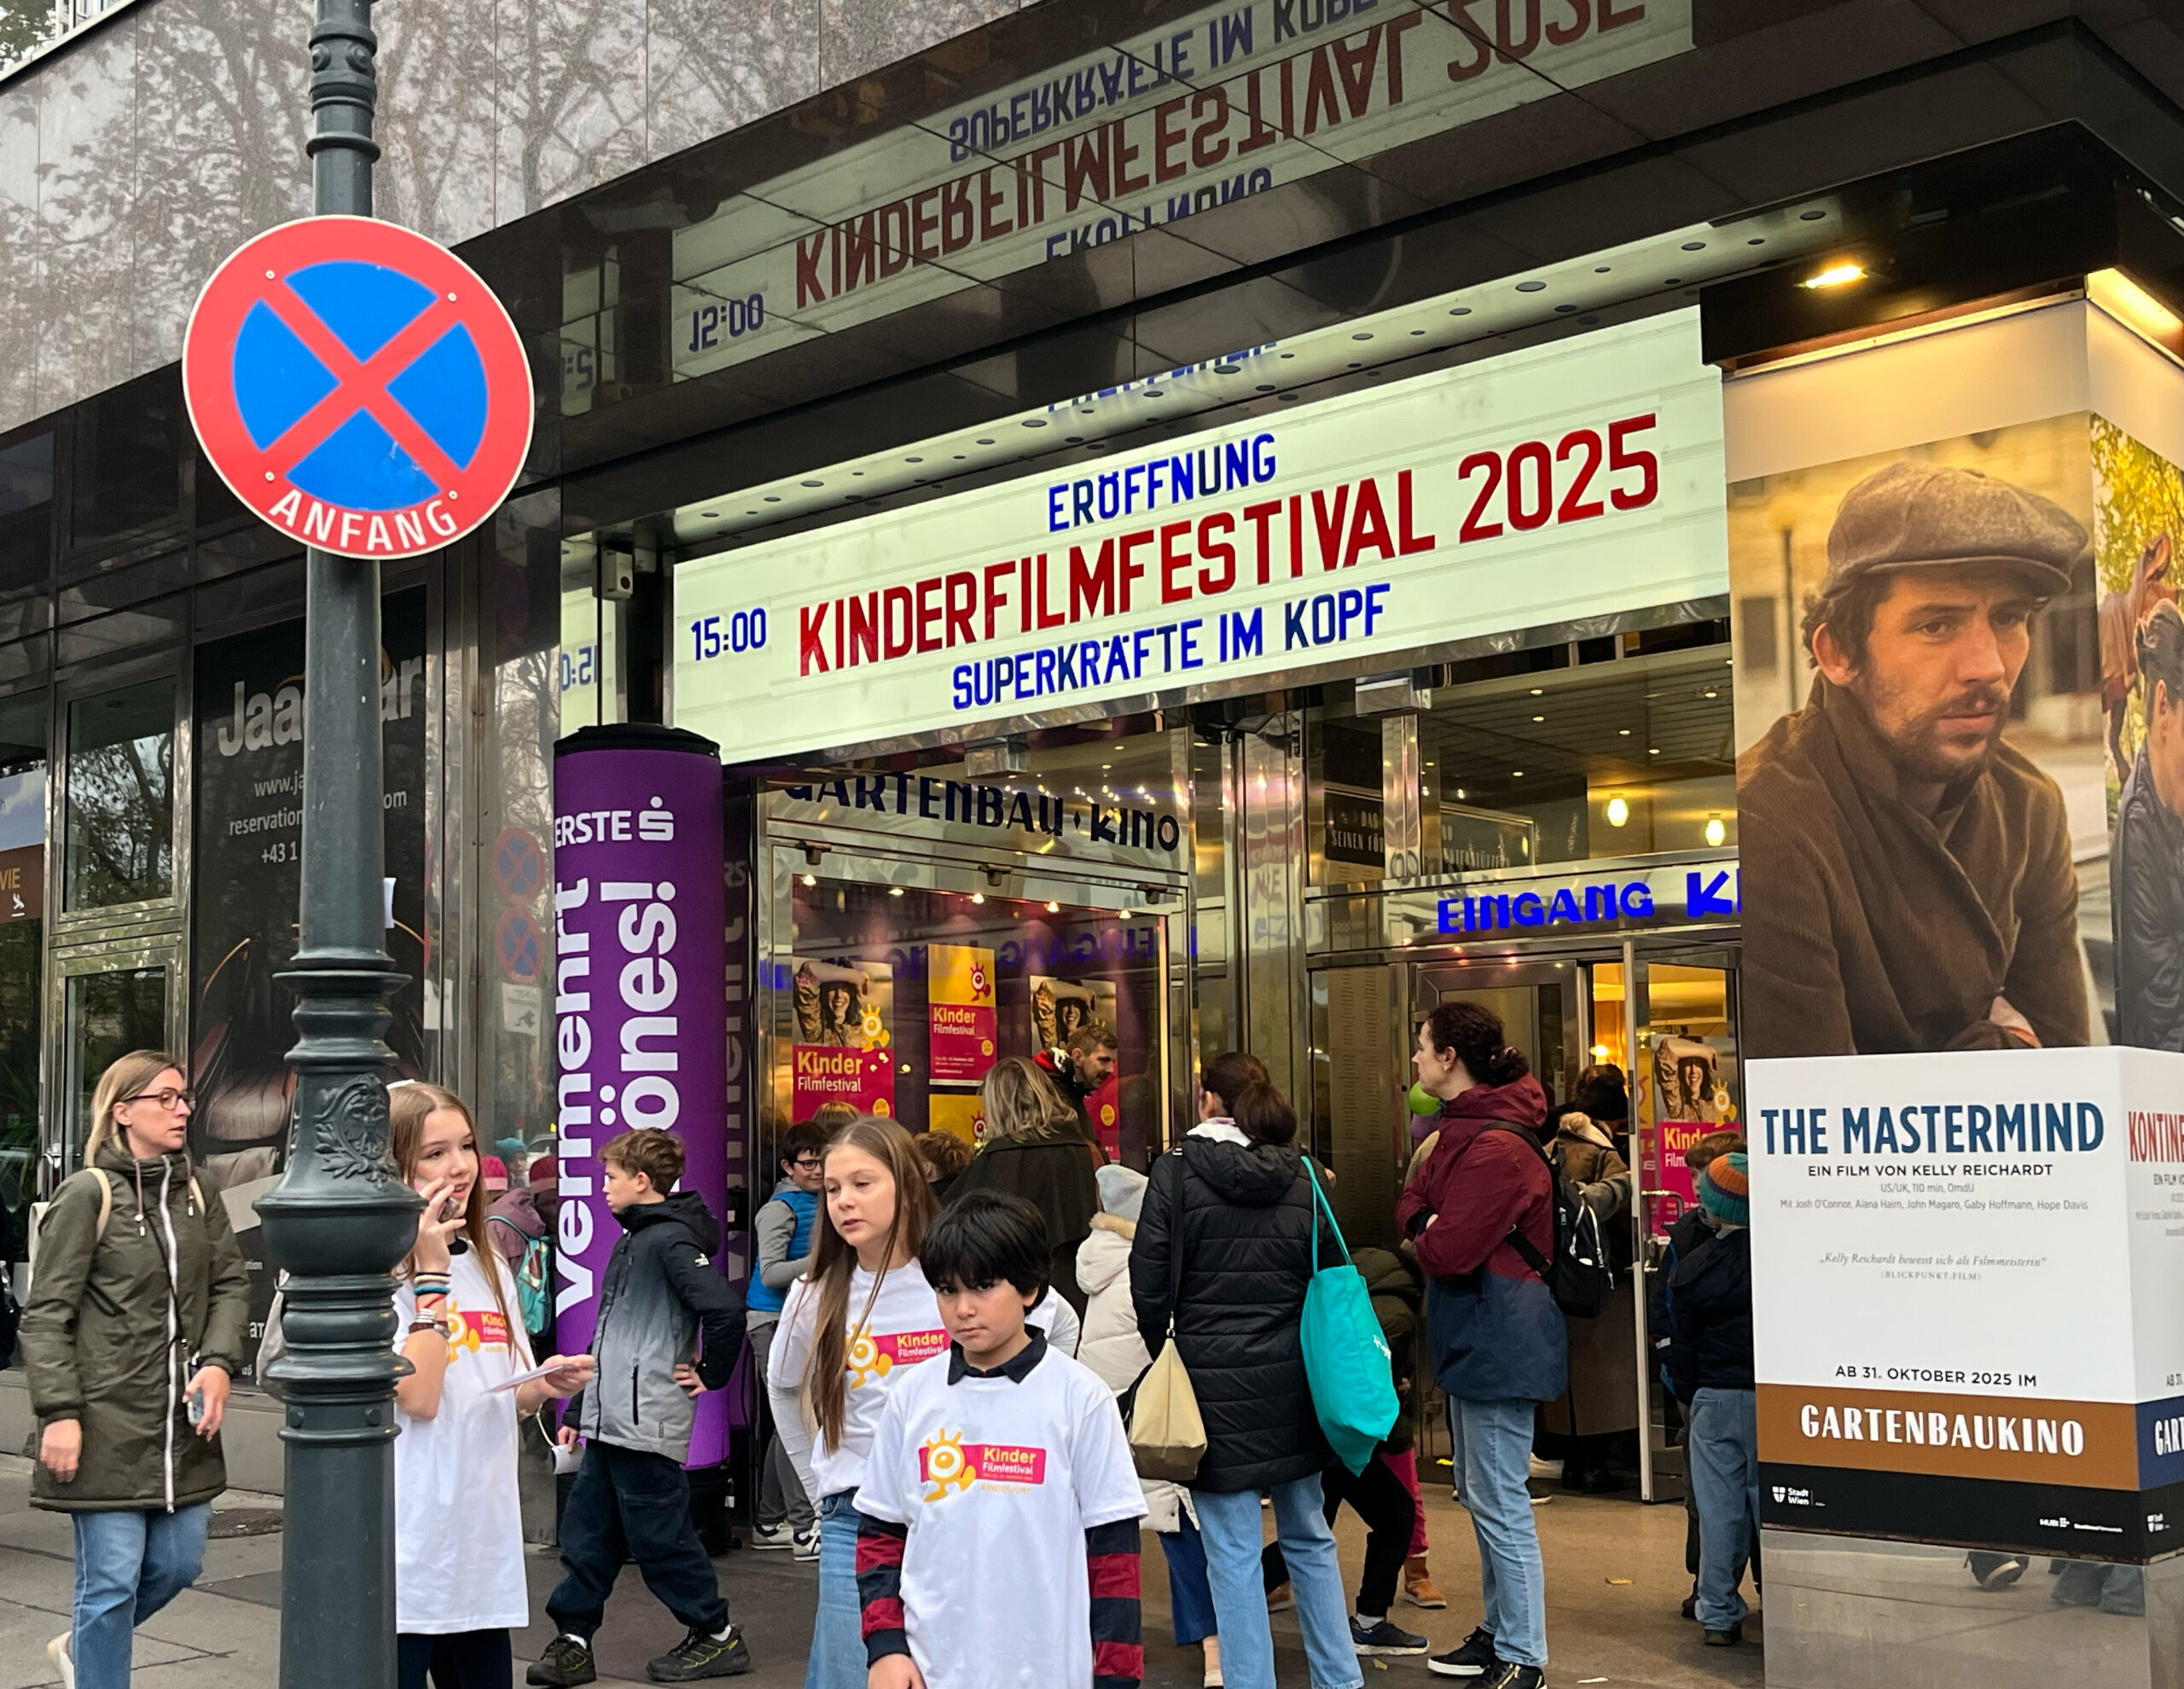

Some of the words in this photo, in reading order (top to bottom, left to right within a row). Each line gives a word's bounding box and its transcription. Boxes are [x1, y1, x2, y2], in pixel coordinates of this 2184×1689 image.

[1048, 433, 1276, 532] ERÖFFNUNG
[268, 490, 458, 554] ANFANG
[800, 470, 1435, 676] KINDERFILMFESTIVAL
[1458, 413, 1658, 543] 2025
[691, 607, 766, 660] 15:00
[953, 619, 1204, 710] SUPERKRÄFTE
[1219, 607, 1263, 663] IM
[1285, 583, 1391, 657] KOPF
[555, 810, 632, 849] ERSTE
[1090, 803, 1180, 852] KINO
[261, 842, 286, 863] +43
[1437, 881, 1655, 934] EINGANG
[933, 1007, 976, 1024] Kinder
[933, 1023, 975, 1036] Filmfestival
[798, 1051, 863, 1075] Kinder
[797, 1077, 863, 1092] Filmfestival
[1760, 1108, 1828, 1155] THE
[1843, 1102, 2105, 1154] MASTERMIND
[1808, 1165, 1832, 1177] EIN
[1837, 1165, 1870, 1176] FILM
[1874, 1165, 1907, 1176] VON
[1912, 1164, 1957, 1176] KELLY
[1963, 1164, 2053, 1176] REICHARDT
[1780, 1199, 1792, 1209] Mit
[1907, 1199, 1926, 1210] John
[1964, 1199, 1986, 1211] Gaby
[2037, 1200, 2061, 1211] Hope
[2063, 1199, 2088, 1210] Davis
[897, 1332, 945, 1348] Kinder
[897, 1344, 944, 1358] Filmfestival
[1836, 1366, 1857, 1378] AB
[1863, 1367, 1882, 1378] 31.
[1887, 1367, 1965, 1383] OKTOBER
[1972, 1372, 2012, 1385] 2025
[2018, 1374, 2036, 1386] IM
[1801, 1404, 2084, 1456] GARTENBAUKINO
[984, 1447, 1037, 1465] Kinder
[982, 1462, 1034, 1475] Filmfestival
